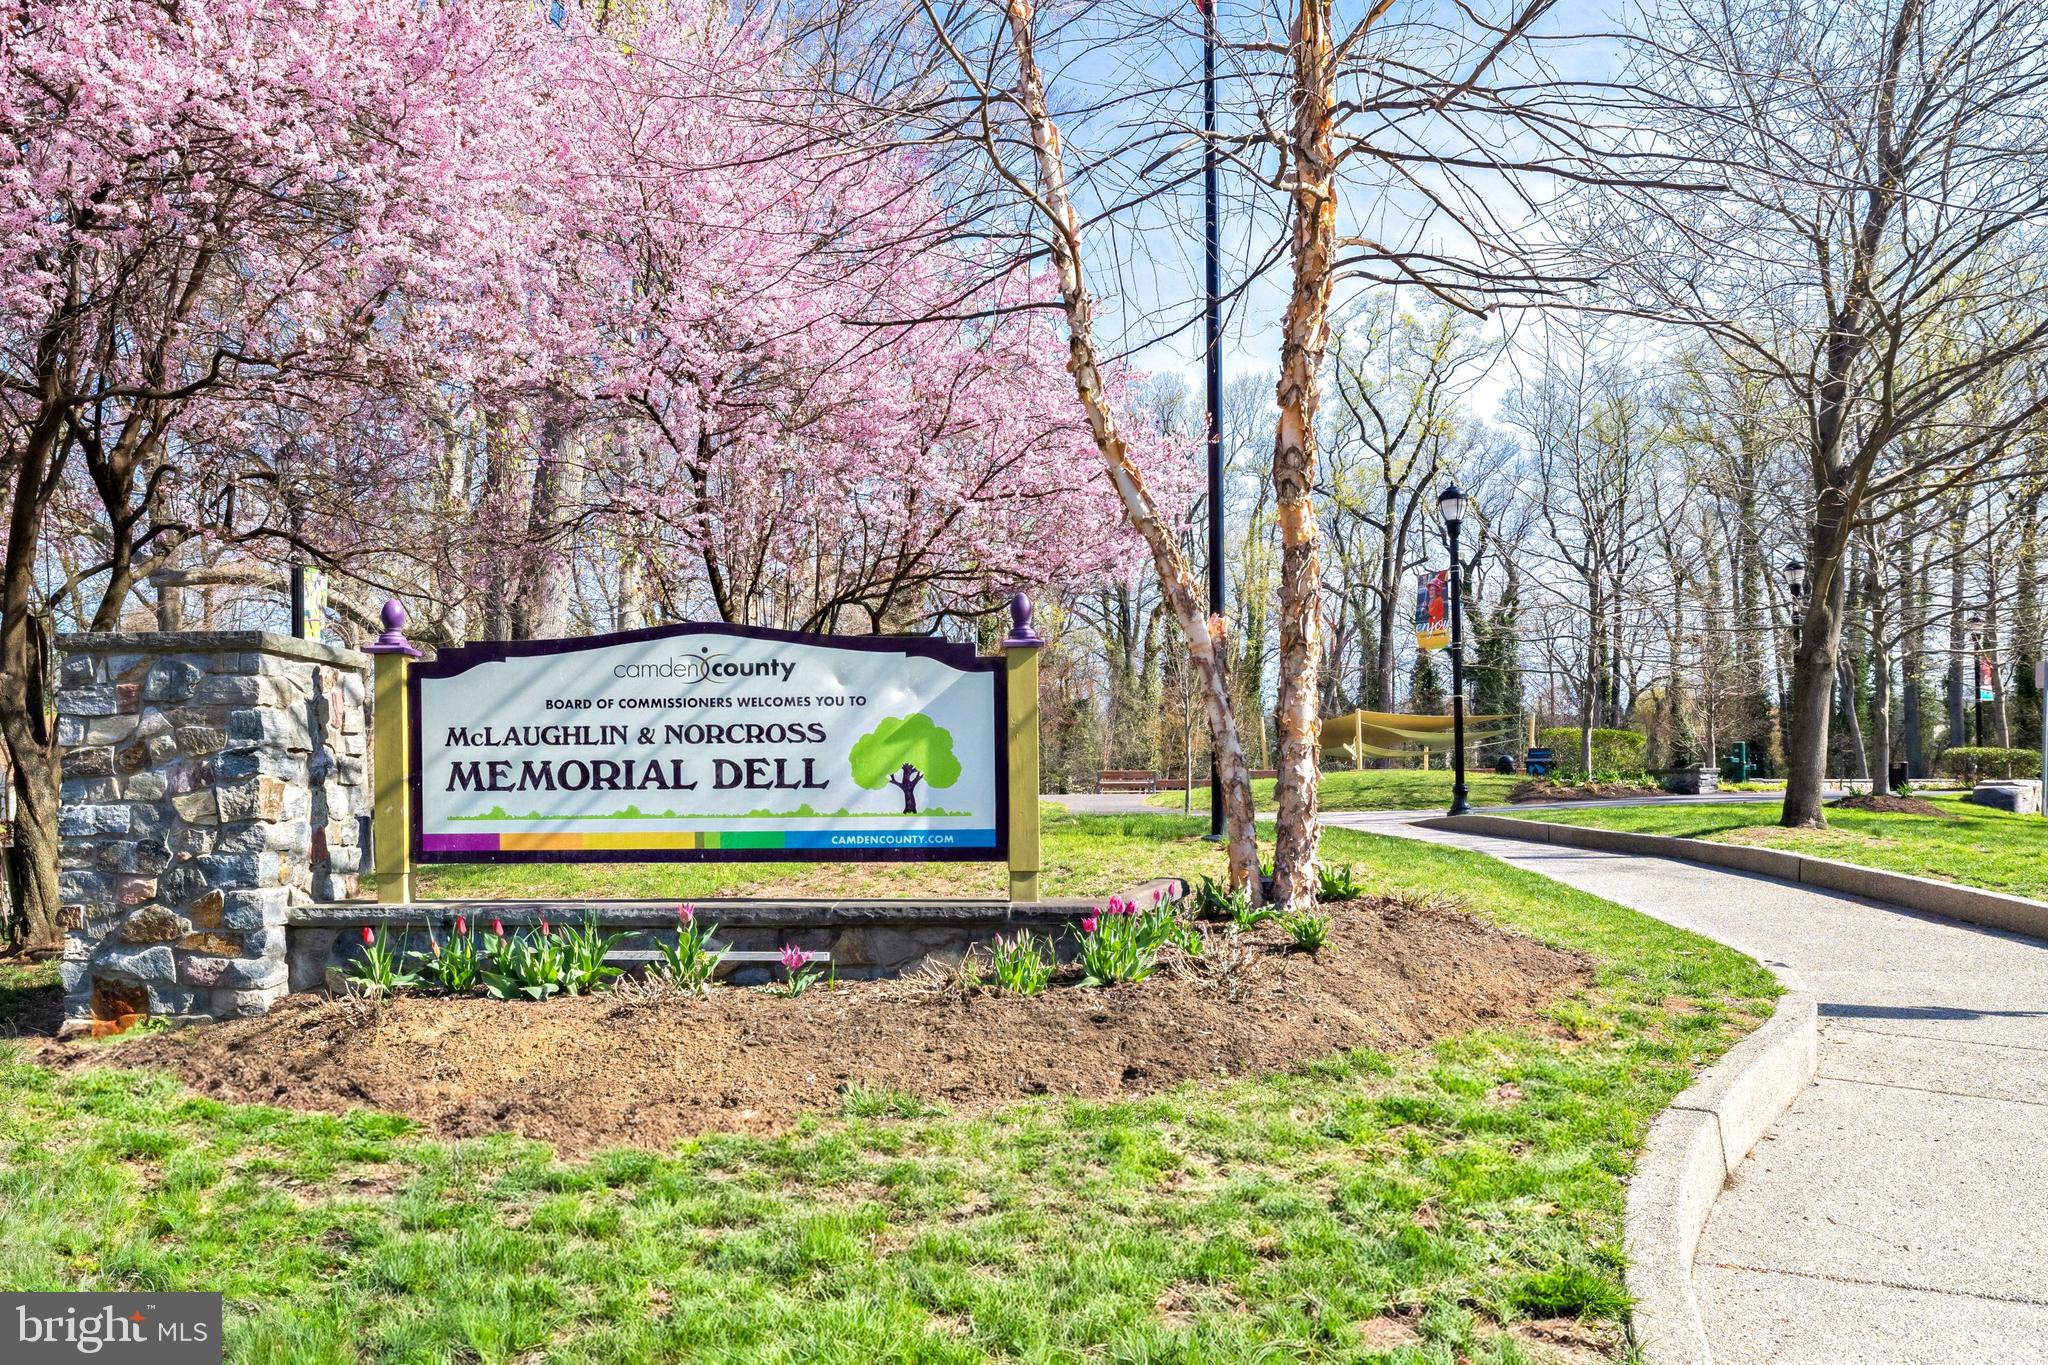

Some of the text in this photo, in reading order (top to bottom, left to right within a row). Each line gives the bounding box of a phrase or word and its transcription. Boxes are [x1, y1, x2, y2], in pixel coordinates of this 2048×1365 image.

[613, 656, 796, 682] camden county
[545, 695, 867, 710] BOARD OF COMMISSIONERS WELCOMES YOU TO
[445, 722, 826, 747] McLAUGHLIN & NORCROSS
[445, 758, 830, 793] MEMORIAL DELL
[831, 834, 955, 846] CAMDENCOUNTY.COM
